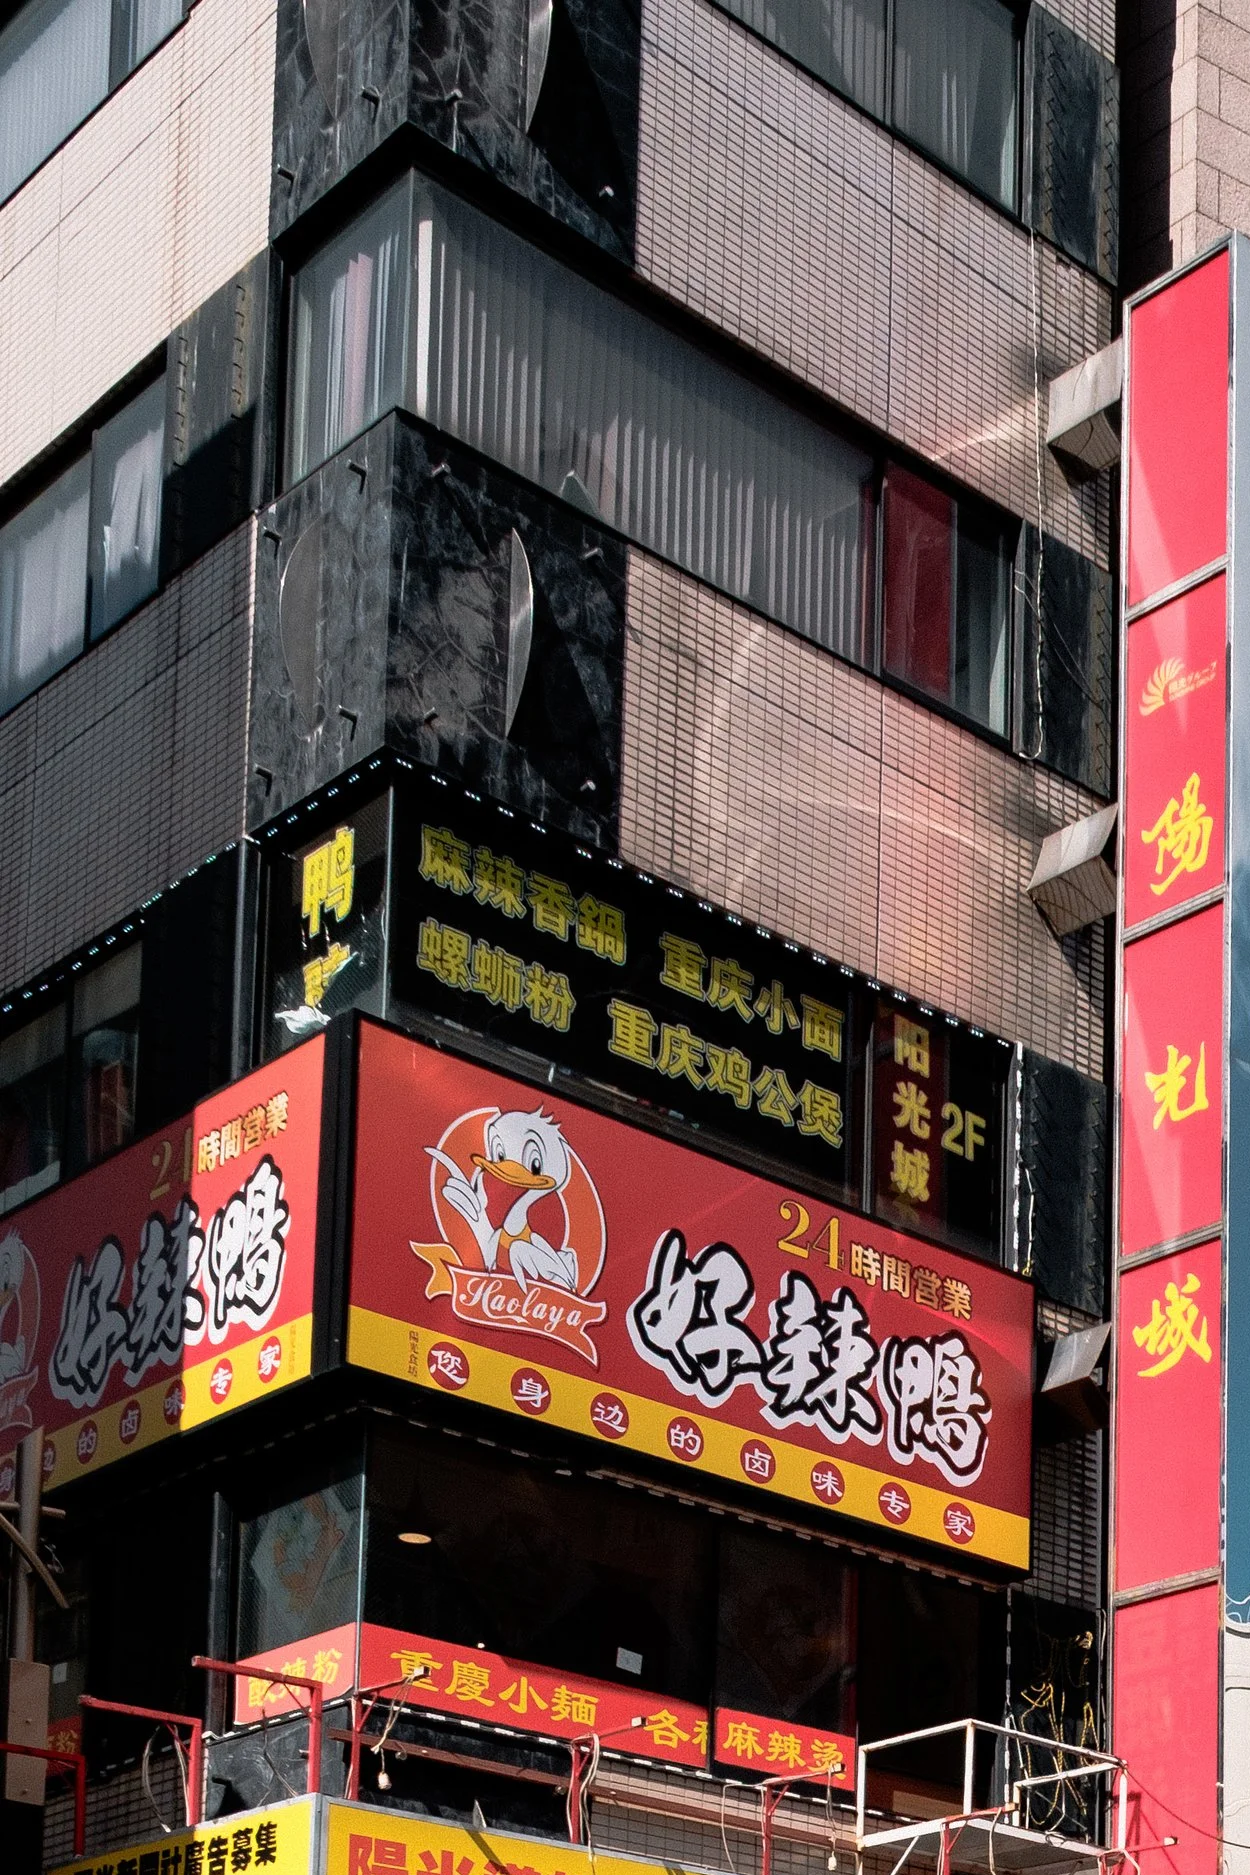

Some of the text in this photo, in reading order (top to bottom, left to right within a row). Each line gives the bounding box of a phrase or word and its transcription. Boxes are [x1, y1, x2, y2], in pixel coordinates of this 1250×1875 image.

[416, 823, 627, 967] 麻辣香鍋
[941, 1101, 987, 1163] 2F
